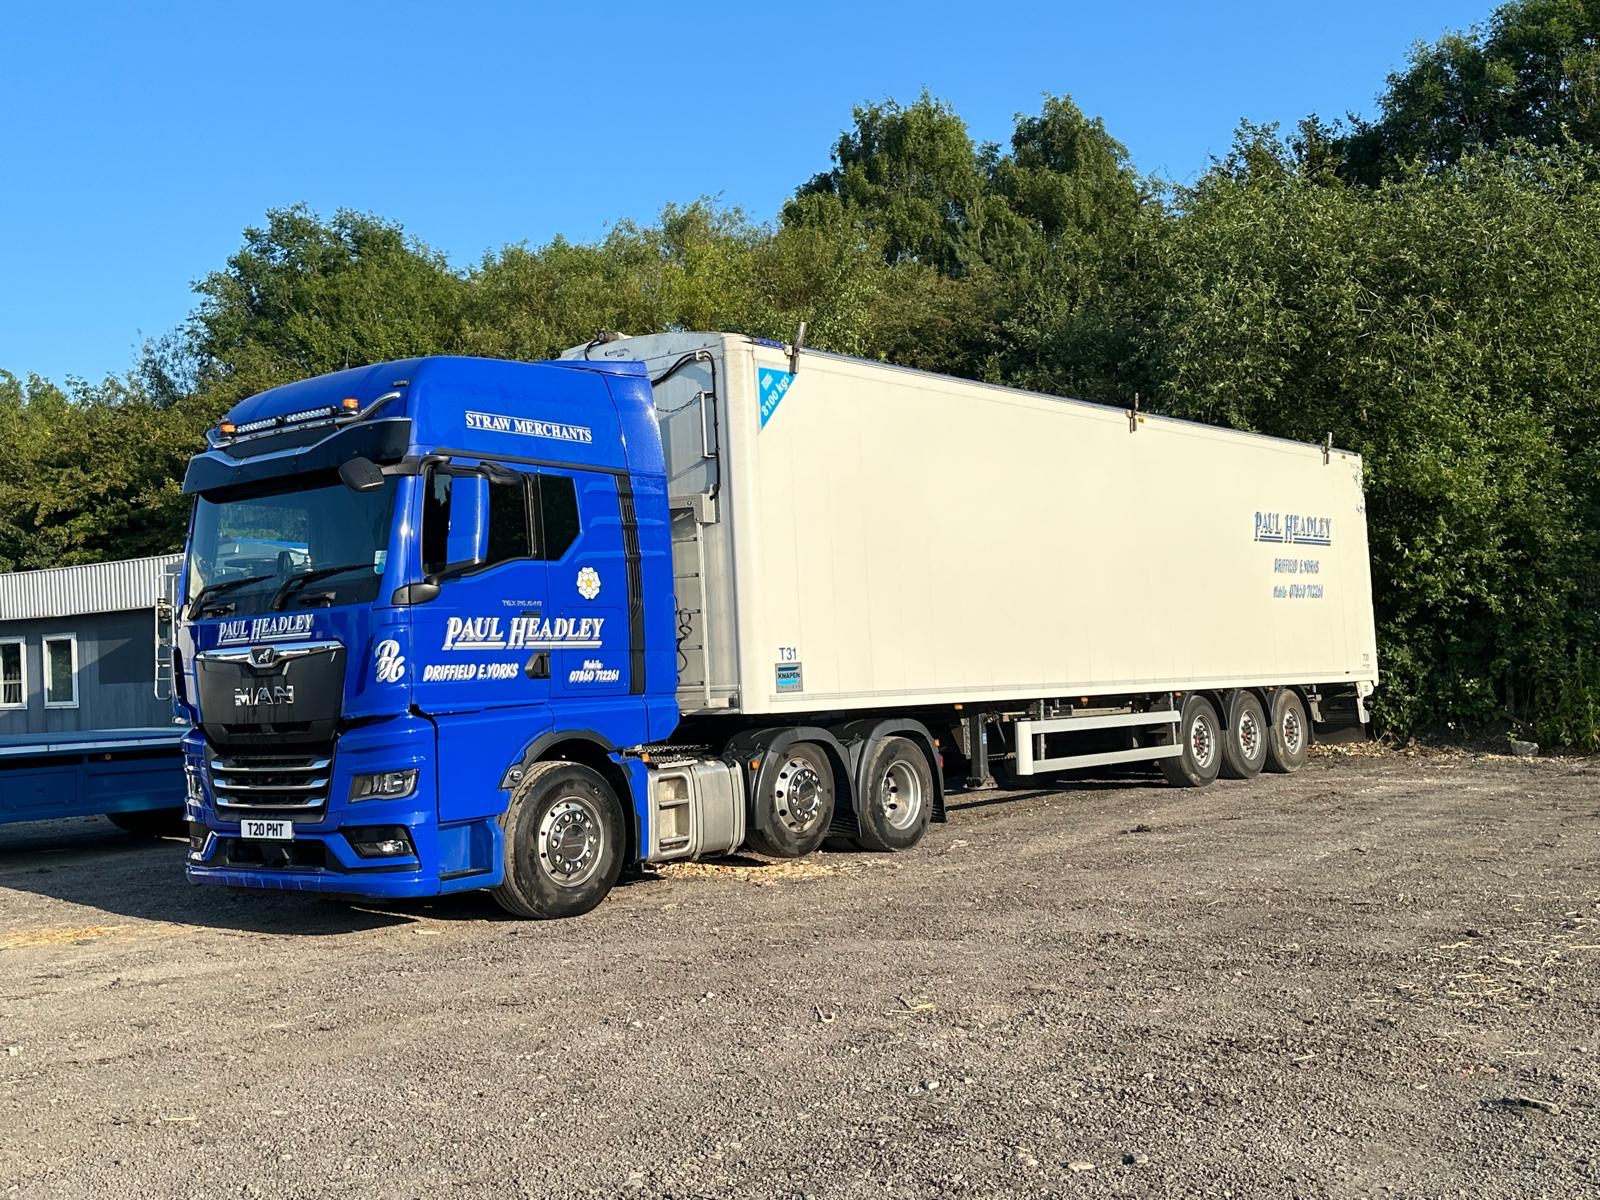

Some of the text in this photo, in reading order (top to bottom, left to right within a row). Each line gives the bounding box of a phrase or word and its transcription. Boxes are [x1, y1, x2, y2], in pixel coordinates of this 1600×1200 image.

[762, 389, 778, 416] 8100
[775, 374, 790, 393] kgs
[465, 413, 592, 441] STRAW MERCHANTS
[1254, 511, 1331, 545] PAUL HEADLEY
[217, 614, 313, 646] PAUL HEADLEY
[442, 617, 604, 650] PAUL HEADLEY
[779, 647, 797, 661] T31
[423, 663, 519, 682] DRIFFIELD E.YORKS
[569, 669, 619, 683] 07860 712261
[234, 685, 294, 706] MAN
[247, 822, 284, 837] T20 PHT
